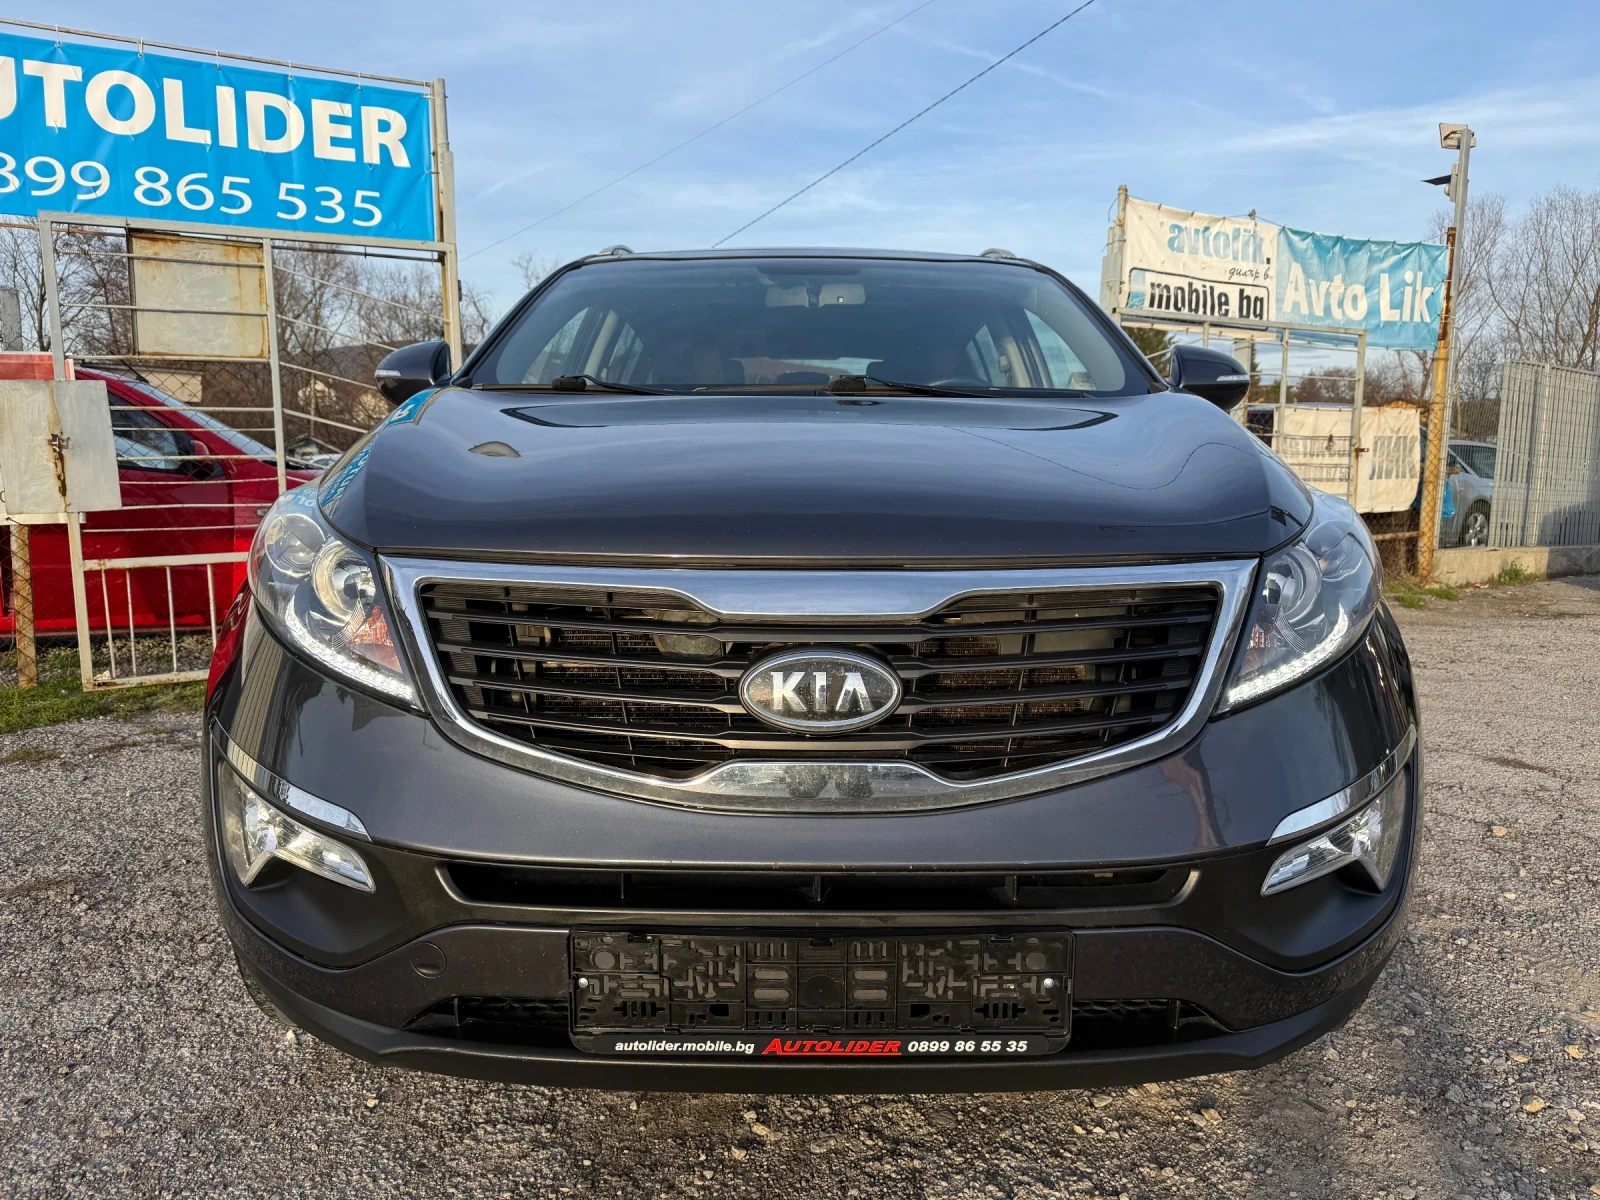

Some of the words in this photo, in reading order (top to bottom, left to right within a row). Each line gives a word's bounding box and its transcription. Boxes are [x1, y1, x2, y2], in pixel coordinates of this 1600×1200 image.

[134, 166, 253, 215] 865
[276, 183, 382, 227] 535
[1283, 262, 1368, 321] Avto
[1379, 270, 1434, 322] Lik
[770, 671, 874, 712] KIA
[615, 1040, 755, 1054] autolider.mobile.bg
[761, 1038, 902, 1056] AUTOLIDER
[907, 1040, 950, 1053] 0899
[954, 1040, 976, 1053] 86
[980, 1040, 1002, 1053] 55
[1006, 1040, 1028, 1053] 35
